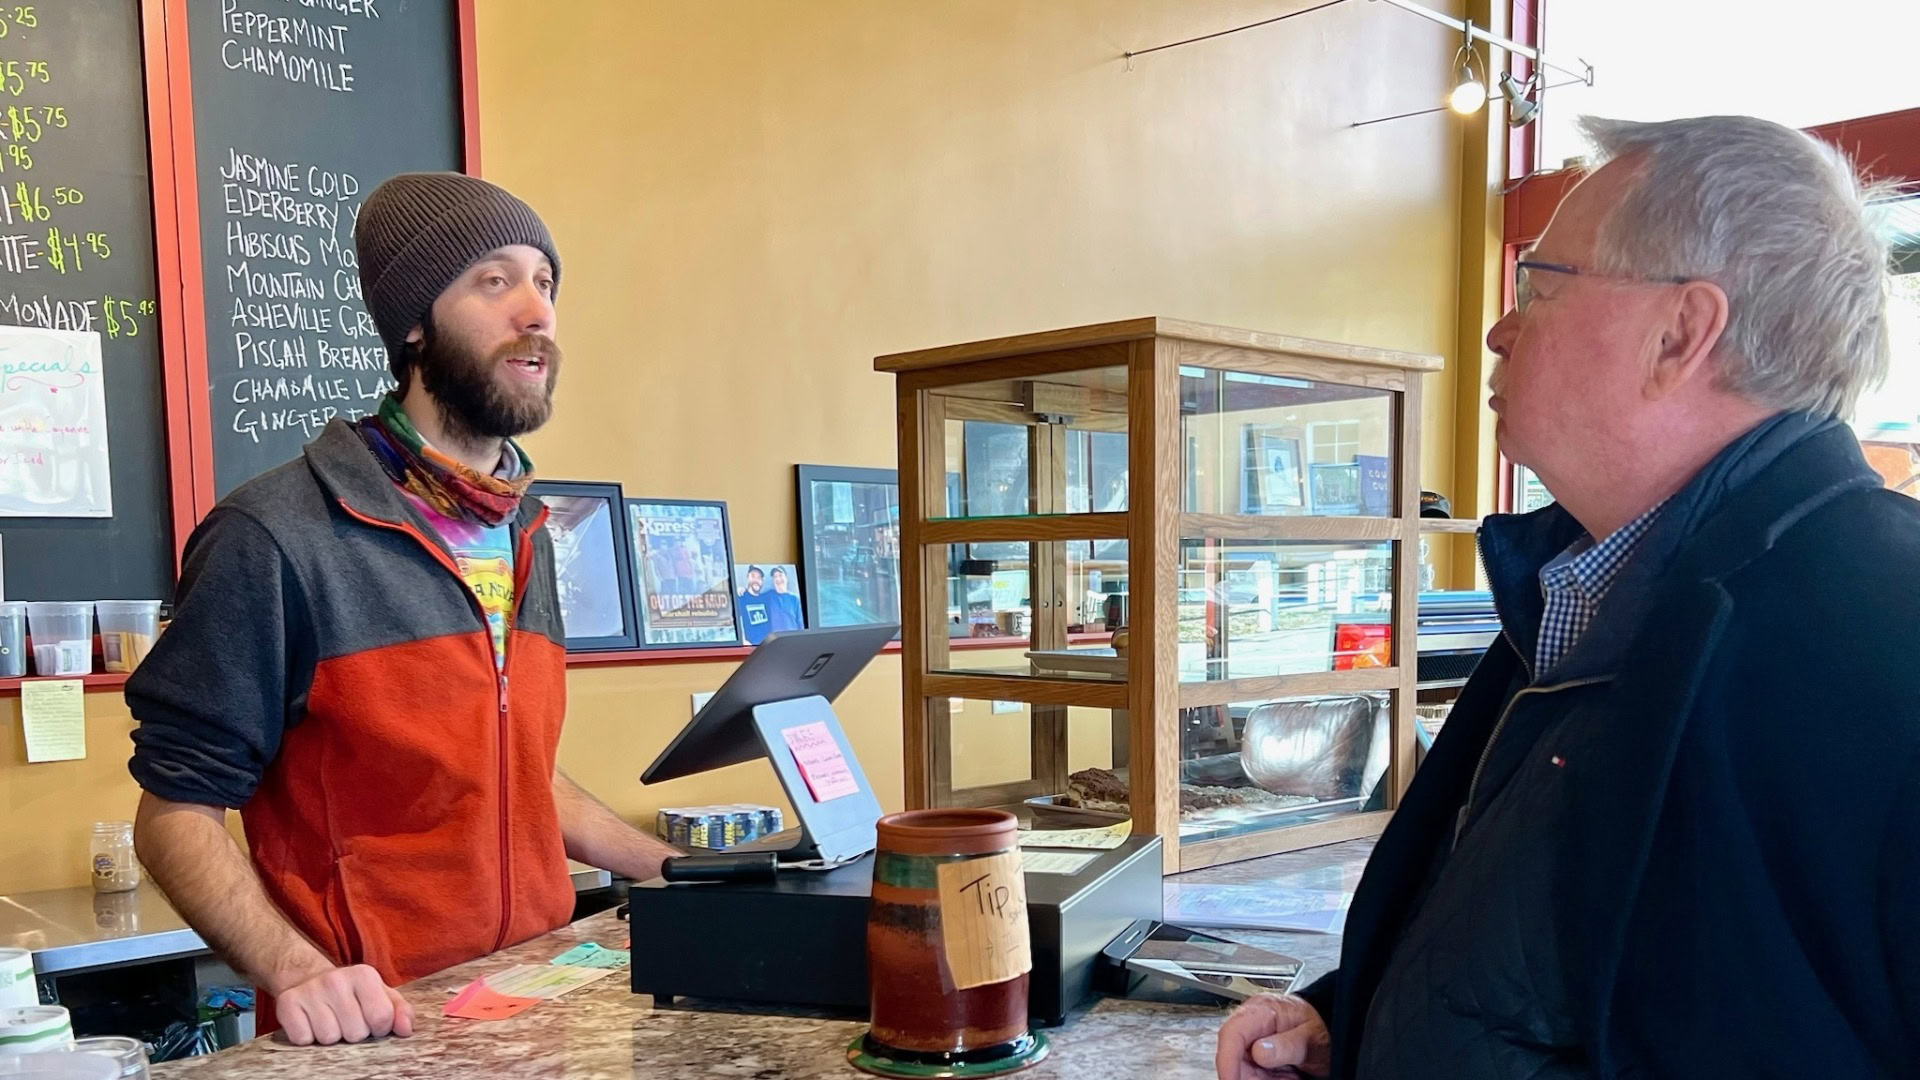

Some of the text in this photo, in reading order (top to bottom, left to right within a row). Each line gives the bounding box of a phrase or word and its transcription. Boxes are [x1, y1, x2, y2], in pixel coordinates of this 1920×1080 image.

[221, 0, 348, 55] PEPPERMINT
[301, 0, 380, 18] GER
[221, 39, 354, 92] CHAMOMILE
[0, 144, 33, 173] .95
[220, 147, 359, 201] JASMINE GOLD
[223, 183, 339, 240] ELDERBERRY
[227, 221, 310, 266] HIBISCUS
[227, 261, 325, 299] MOUNTAIN
[104, 295, 156, 340] $5.95
[231, 297, 333, 333] ASHEVILLE
[0, 344, 98, 393] pecials
[235, 332, 308, 369] PISGAH
[232, 374, 351, 403] CHAMOMILE
[638, 517, 696, 537] Xpress
[650, 592, 728, 610] OUT OF THE MUD
